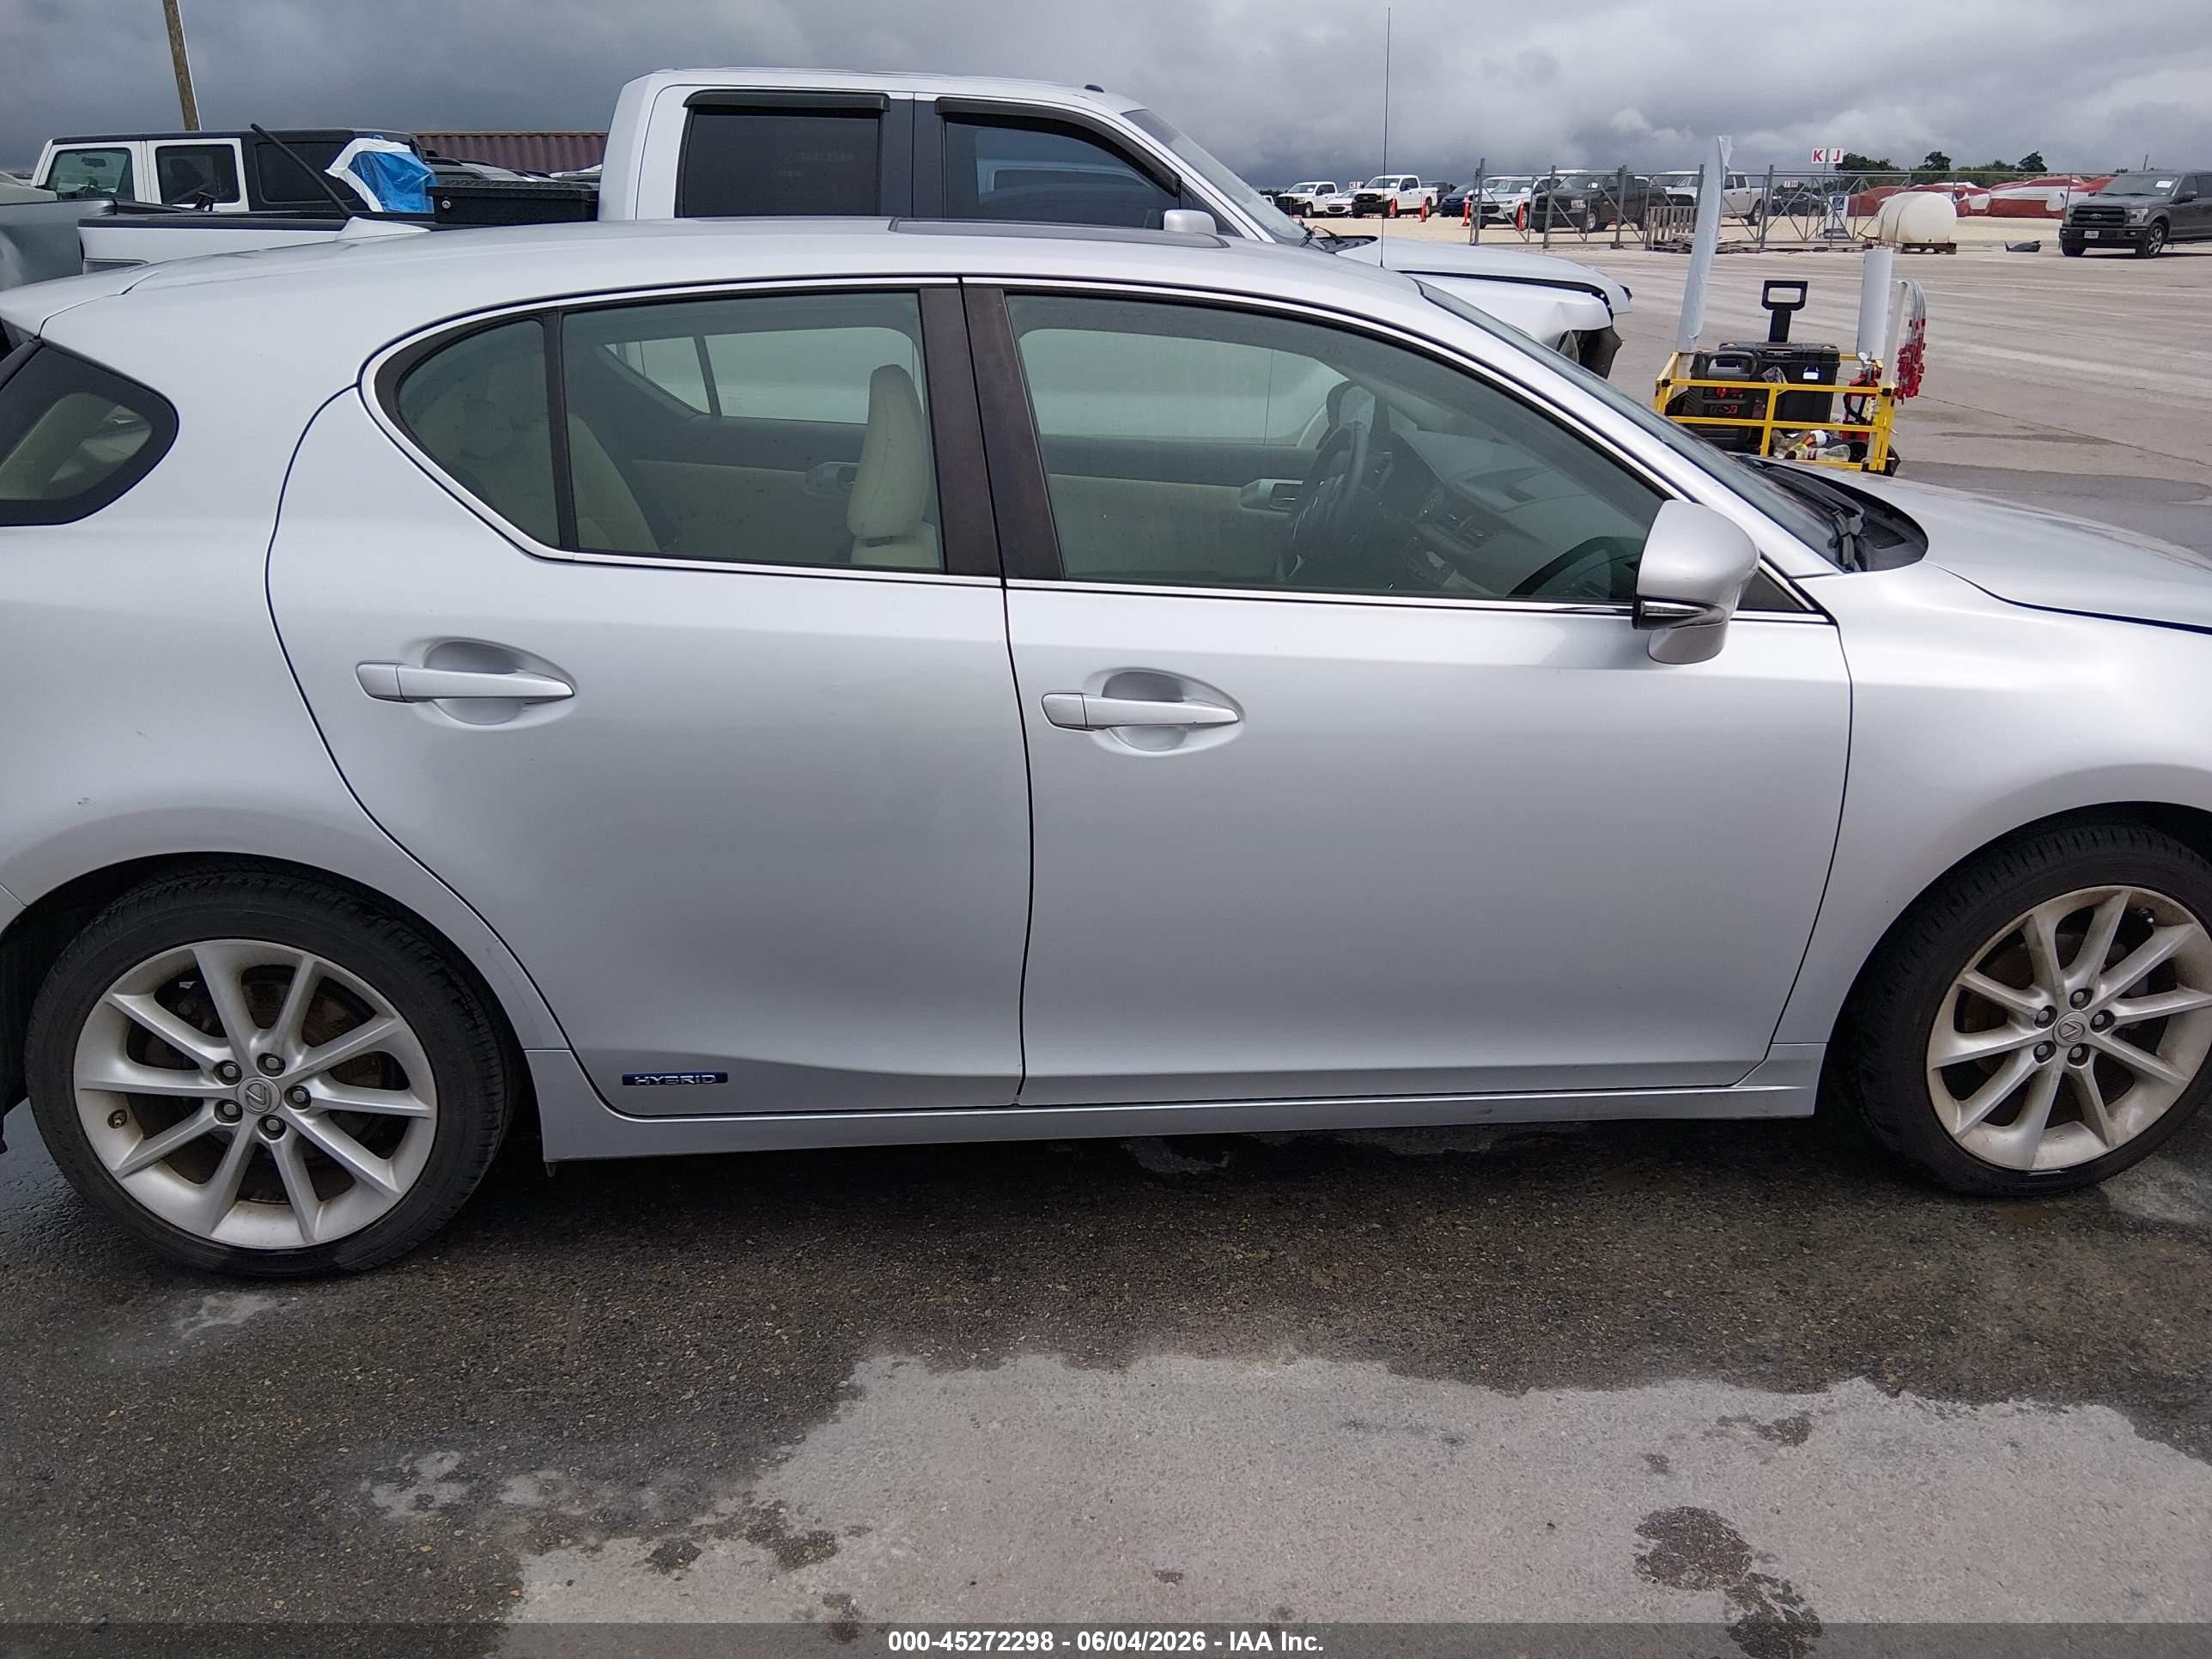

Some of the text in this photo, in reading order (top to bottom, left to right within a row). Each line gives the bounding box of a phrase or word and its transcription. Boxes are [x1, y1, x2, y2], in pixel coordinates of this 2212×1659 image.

[1813, 149, 1841, 162] K J
[634, 1075, 717, 1085] HYBRID
